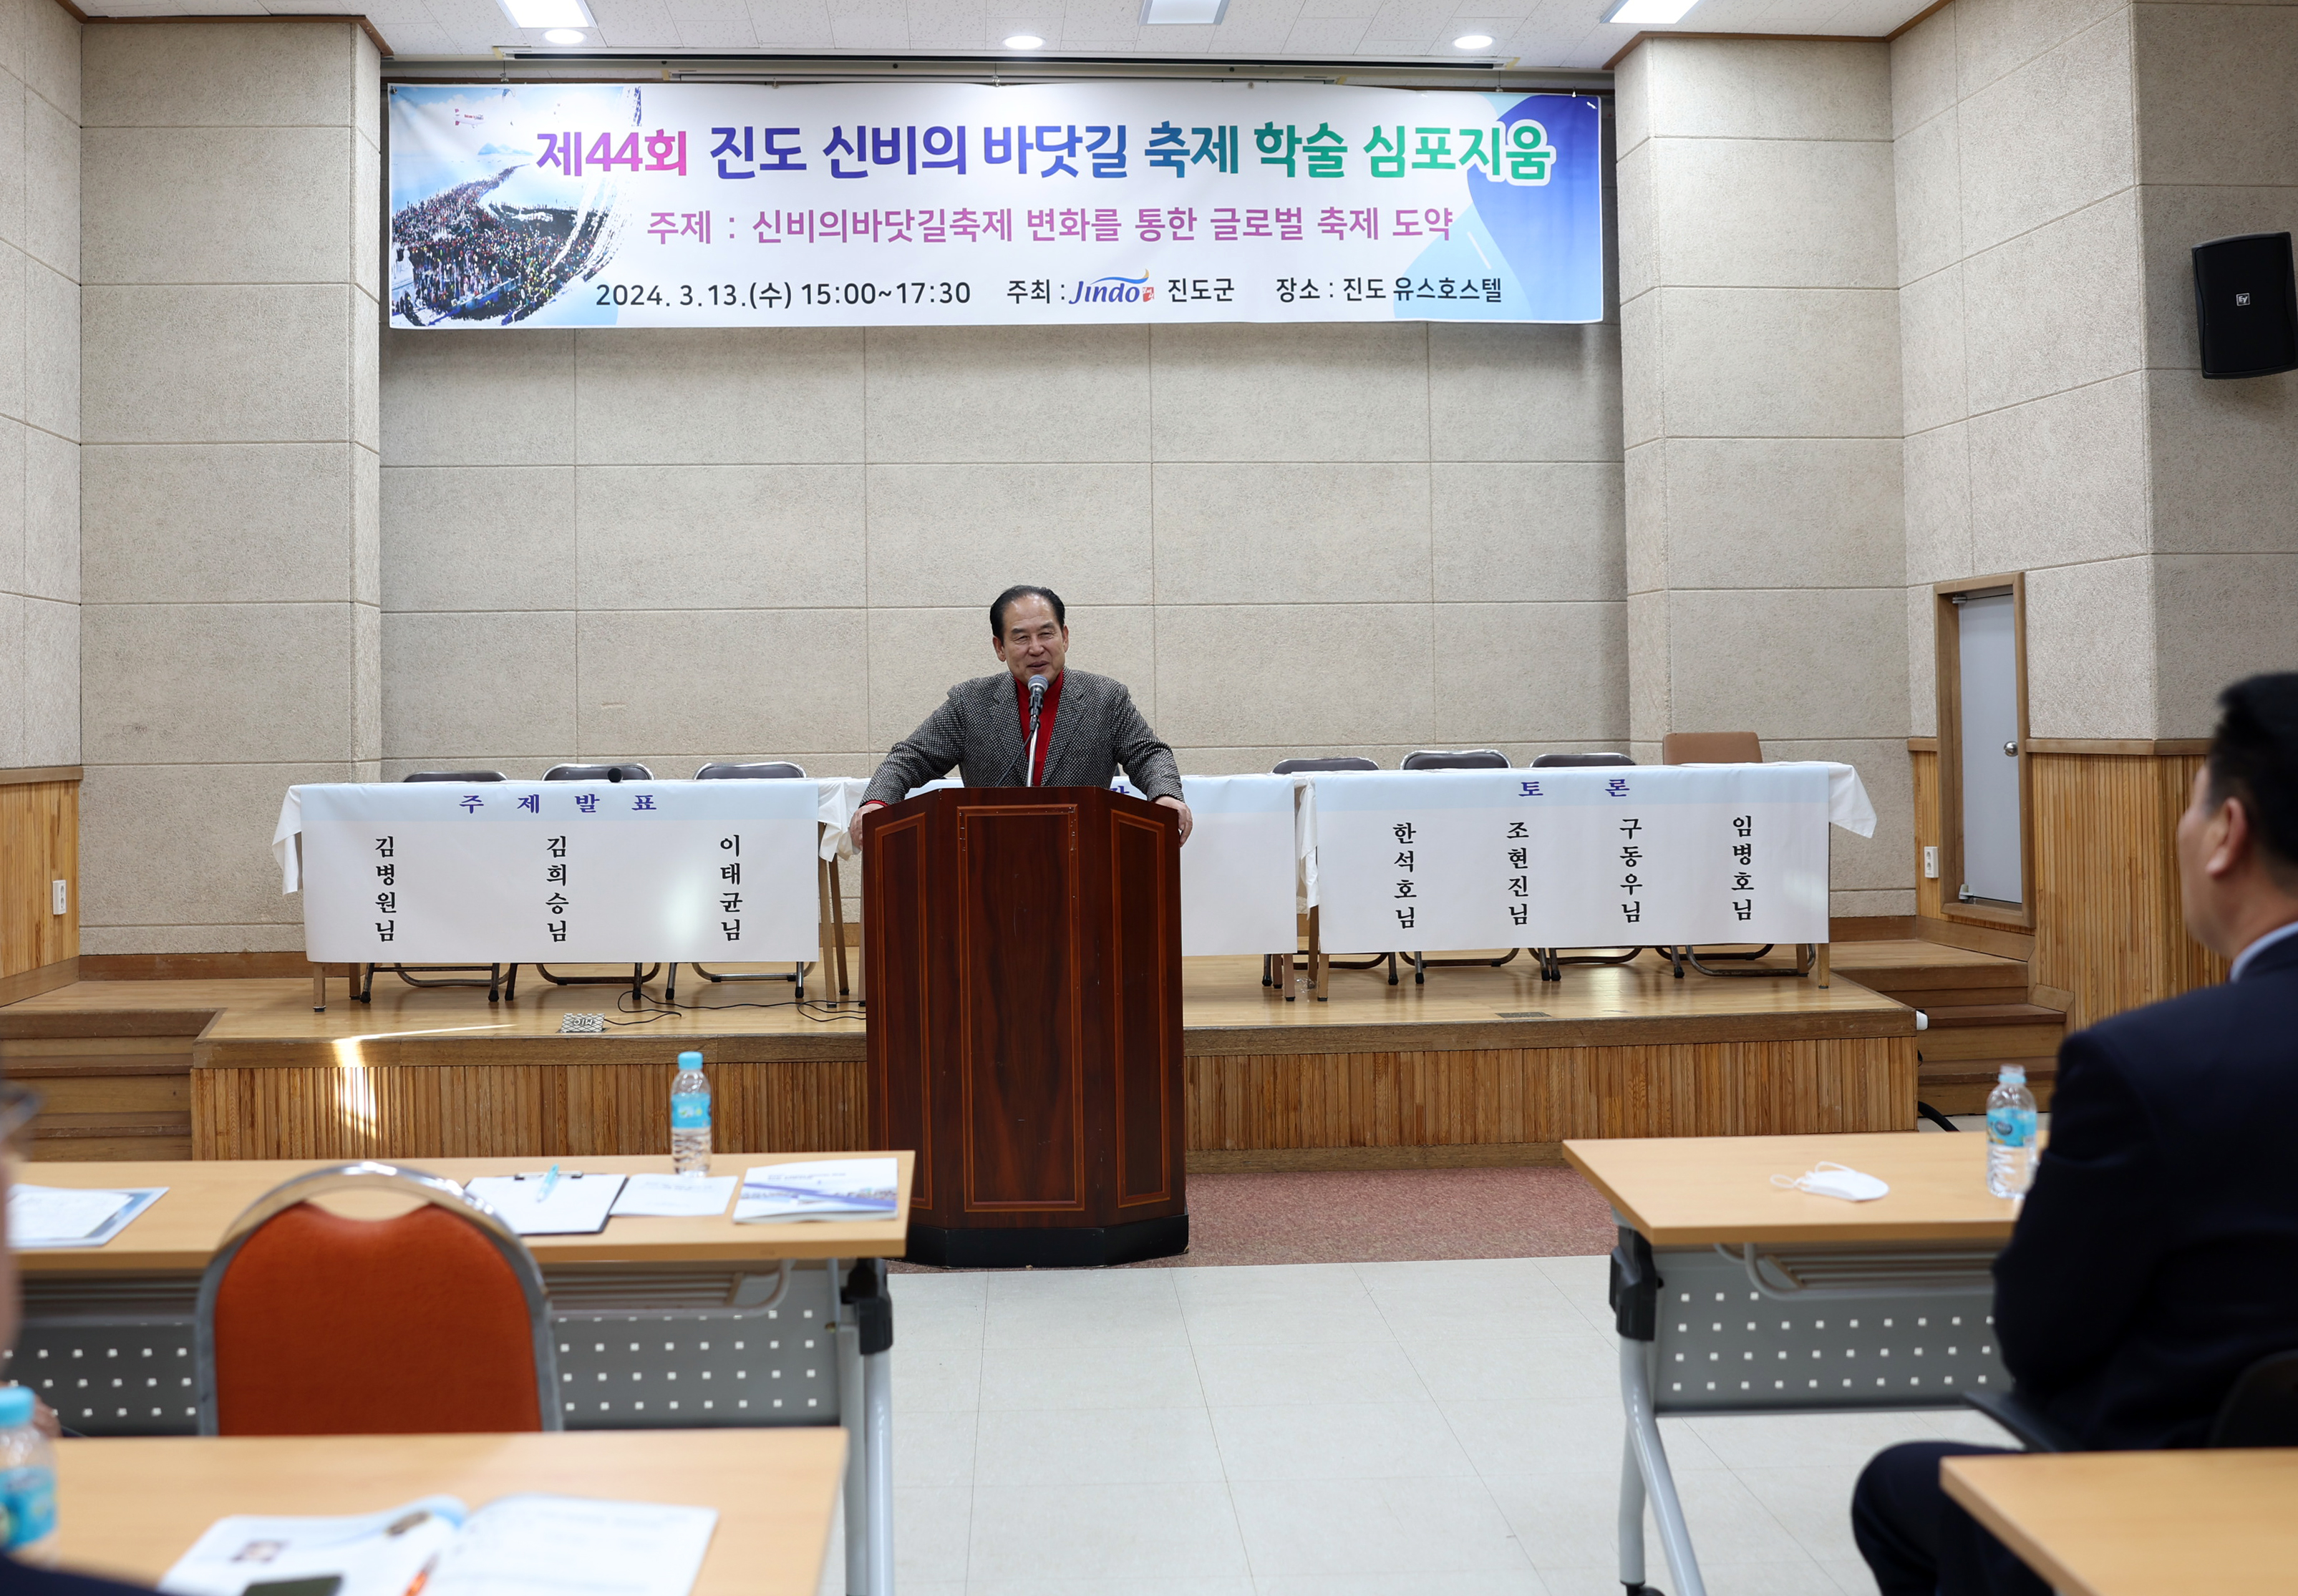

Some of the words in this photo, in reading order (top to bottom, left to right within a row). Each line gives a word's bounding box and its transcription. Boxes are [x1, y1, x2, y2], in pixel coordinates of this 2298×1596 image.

[535, 128, 687, 177] 제44회
[709, 126, 808, 180] 진도
[822, 125, 966, 179] 신비의
[984, 124, 1128, 179] 바닷길
[1144, 120, 1239, 179] 축제
[1254, 120, 1348, 178] 학술
[1362, 125, 1551, 180] 심포지움
[647, 210, 711, 245] 주제
[752, 208, 1012, 243] 신비의바닷길축제
[1027, 208, 1123, 242] 변화를
[1135, 206, 1198, 243] 통한
[1210, 207, 1304, 241] 글로벌
[1317, 206, 1379, 241] 축제
[1392, 208, 1453, 241] 도약
[801, 281, 971, 305] 15:00~17:30
[1007, 278, 1050, 304] 주최
[1068, 281, 1140, 305] Jindo
[1168, 278, 1235, 303] 진도군
[1276, 277, 1321, 303] 장소
[1343, 277, 1387, 301] 진도
[1393, 277, 1502, 303] 유스호스텔
